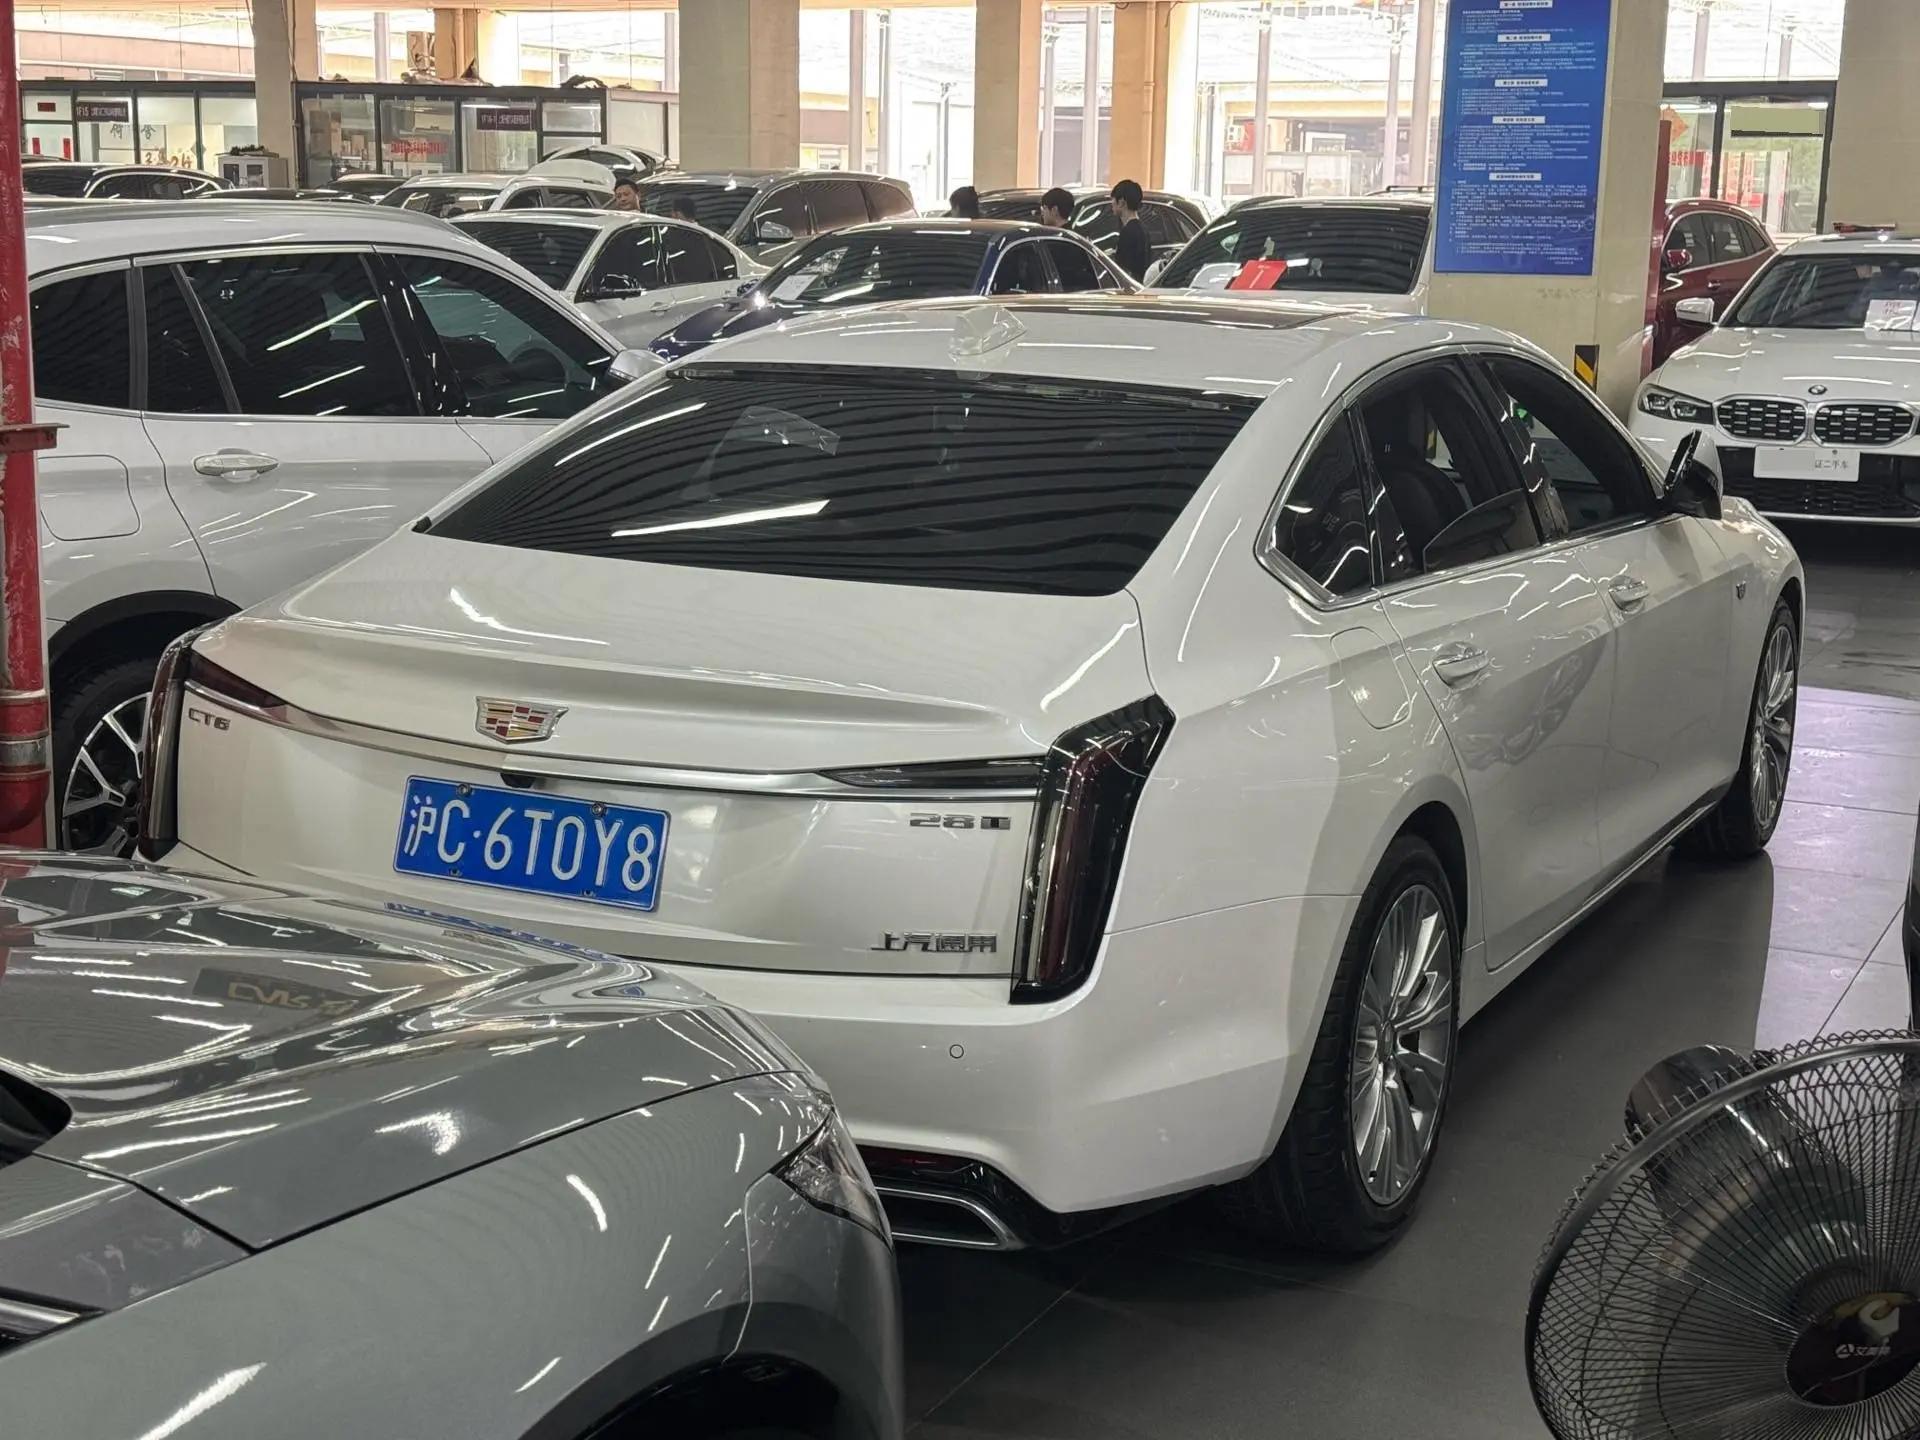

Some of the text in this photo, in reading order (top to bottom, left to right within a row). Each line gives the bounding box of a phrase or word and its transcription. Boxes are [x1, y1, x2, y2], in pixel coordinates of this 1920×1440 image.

[188, 707, 231, 731] CT6
[909, 812, 1012, 830] 28T
[870, 930, 997, 953] 上汽通用
